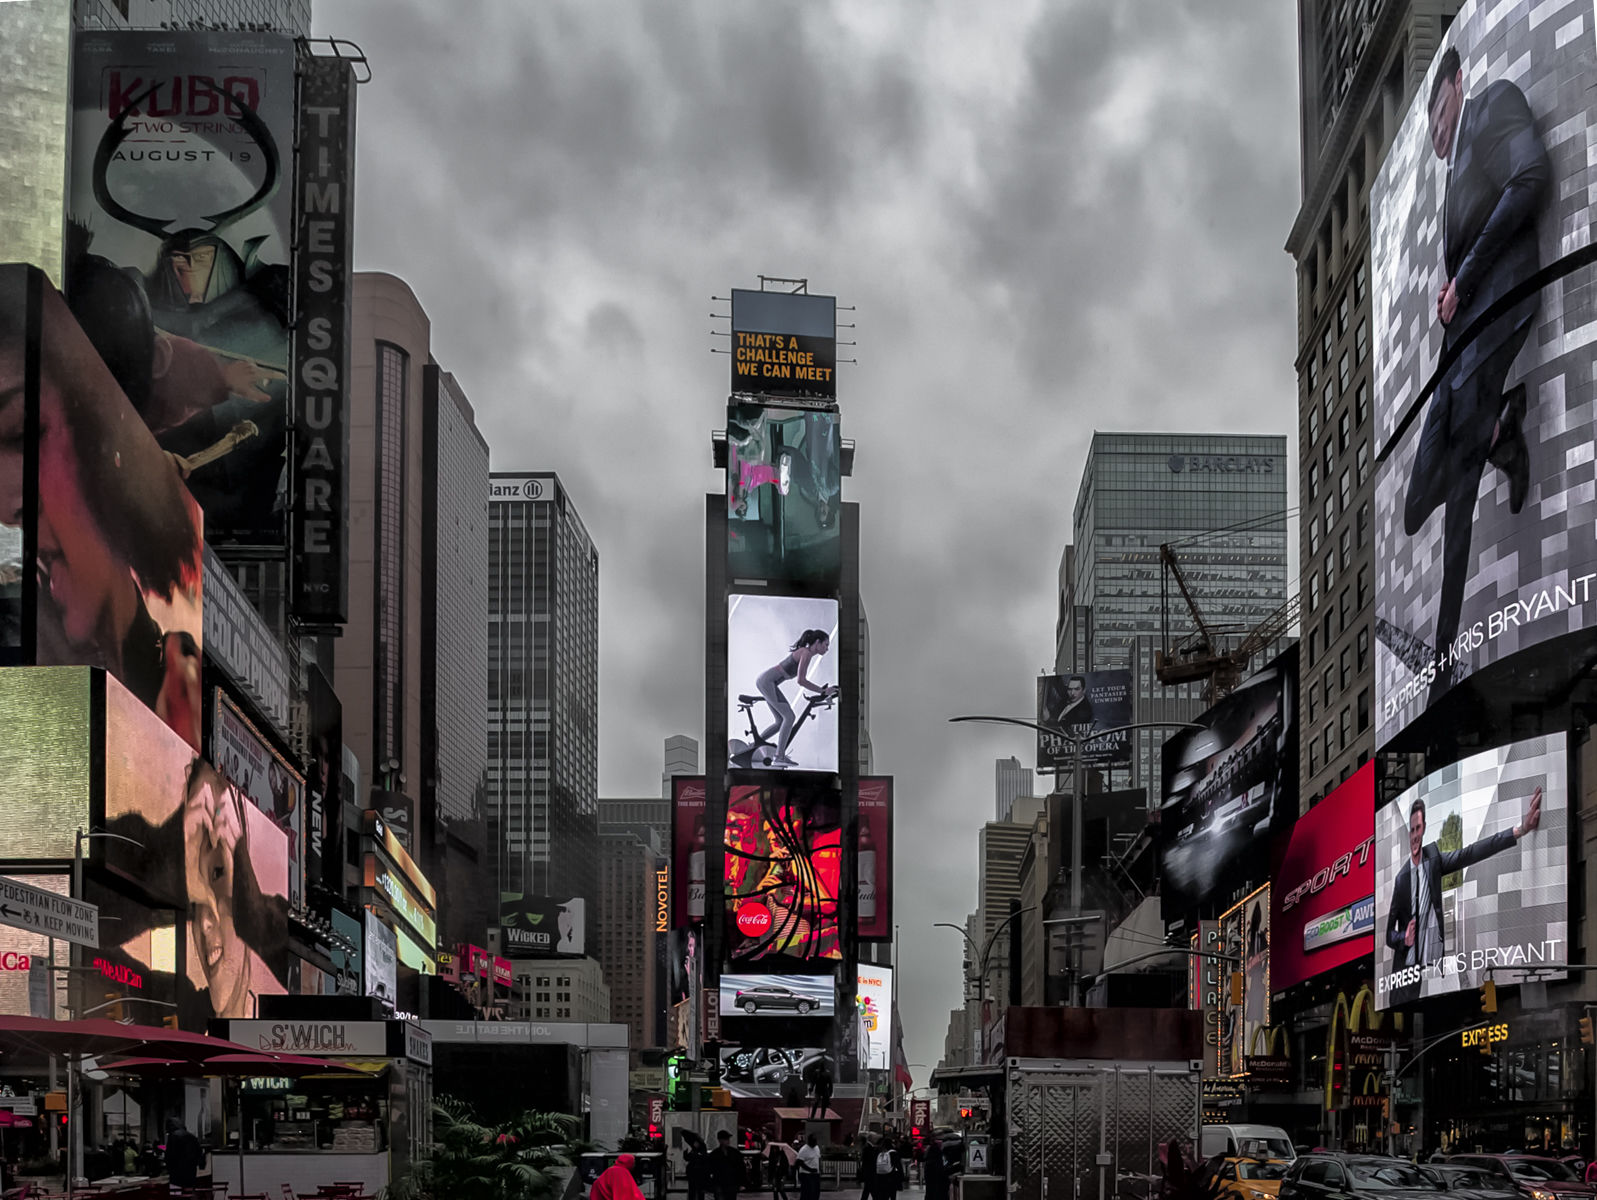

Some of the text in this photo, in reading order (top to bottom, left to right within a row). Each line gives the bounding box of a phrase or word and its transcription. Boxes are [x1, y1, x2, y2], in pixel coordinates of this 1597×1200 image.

[109, 72, 259, 119] KUBO
[180, 122, 248, 134] STRING
[112, 151, 251, 161] AUGUST 19
[302, 107, 339, 554] TIMES SQUARE
[737, 332, 799, 349] THAT'S A
[736, 348, 814, 366] CHALLENGE
[736, 362, 832, 381] WE CAN MEET
[1189, 456, 1274, 473] BARCLAYS
[1384, 661, 1437, 720] EXPRESS
[1448, 621, 1484, 665] KRIS
[1488, 573, 1597, 640] BRYANT
[1039, 729, 1127, 748] PHATOM
[1047, 746, 1061, 755] OF
[1084, 742, 1120, 752] OPERA
[311, 790, 322, 857] NEW
[1282, 834, 1374, 912] SPORT
[656, 865, 668, 933] NOVOTEL
[51, 900, 73, 916] FLOW
[74, 906, 94, 923] ZONE
[738, 913, 768, 925] Coca-Cola
[44, 915, 94, 941] KEEP MOVING
[1378, 964, 1421, 994] EXPRESS
[1432, 953, 1467, 977] KRIS
[1471, 939, 1562, 971] BRYANT
[1206, 931, 1217, 1045] PALACE
[271, 1024, 345, 1048] S'WICH
[652, 1099, 663, 1123] tkts
[915, 1102, 927, 1126] tkts
[973, 1149, 983, 1162] A
